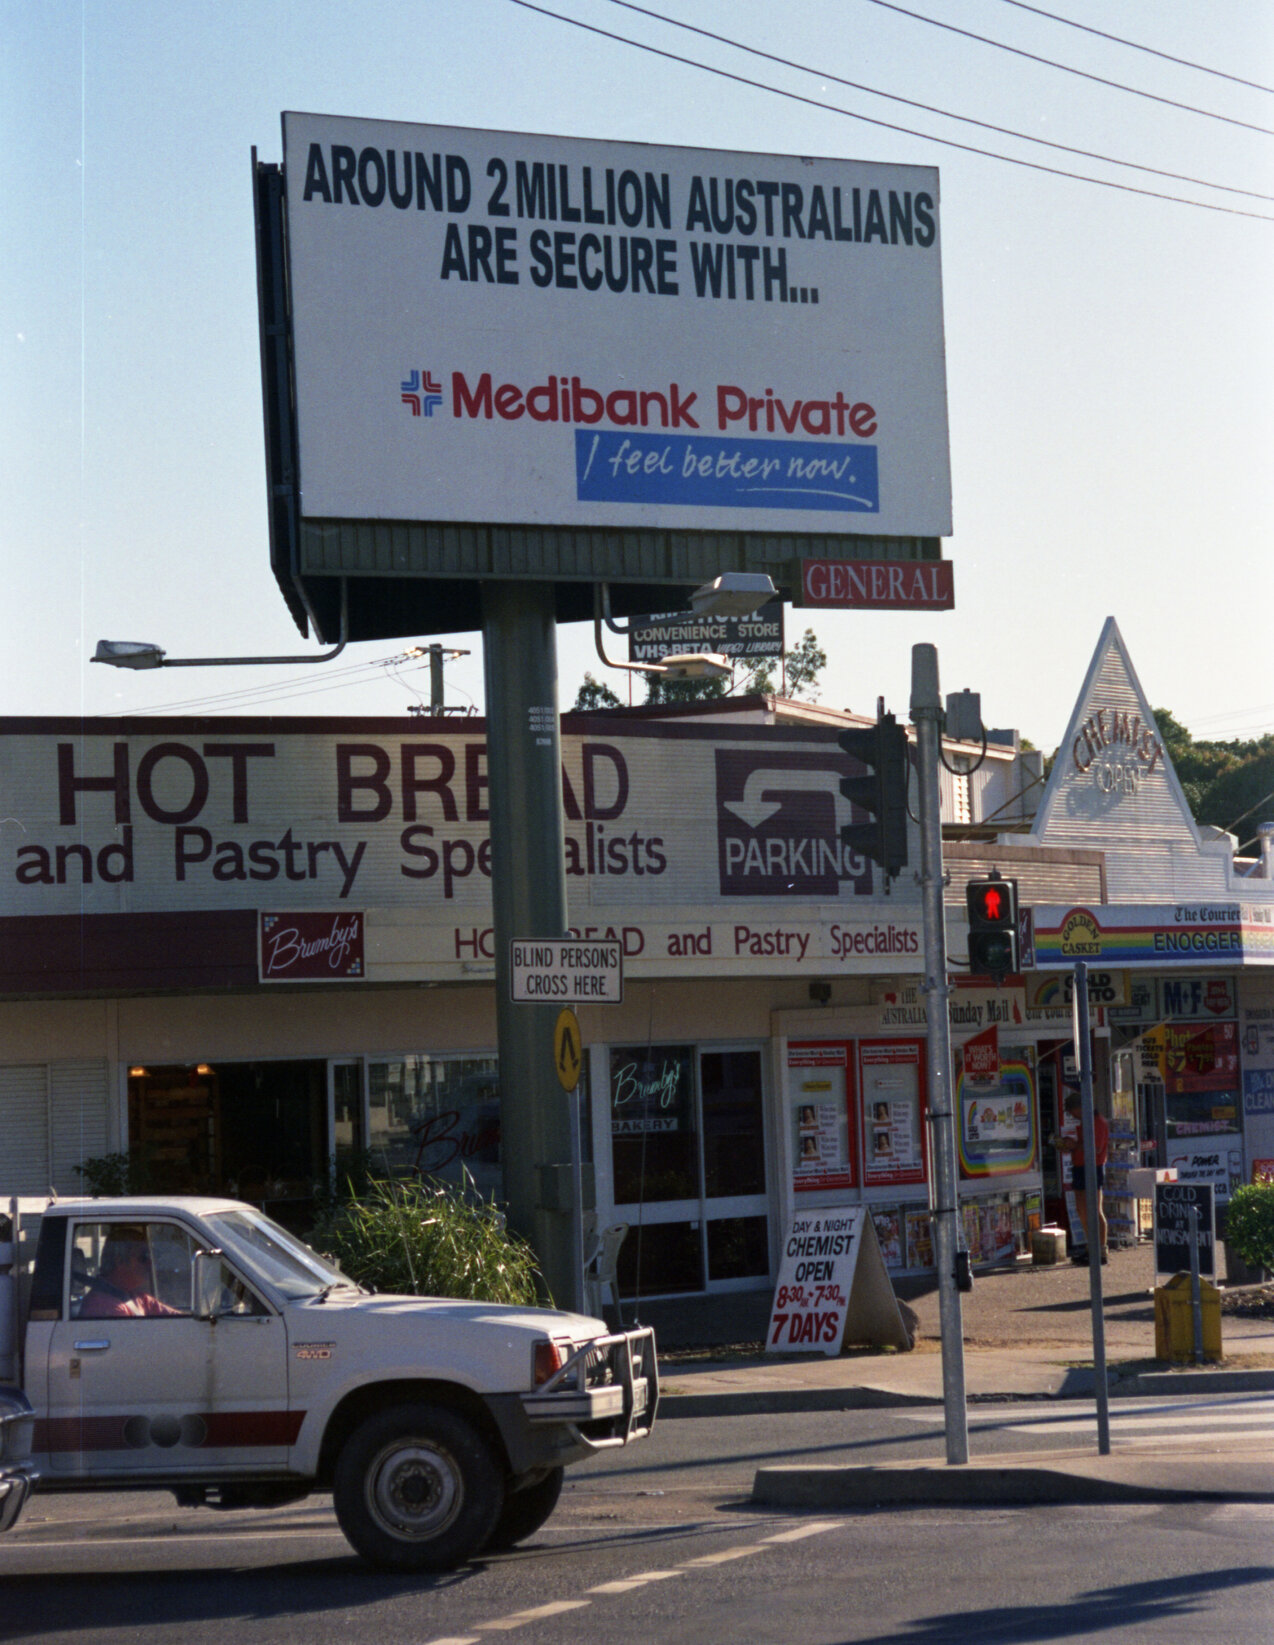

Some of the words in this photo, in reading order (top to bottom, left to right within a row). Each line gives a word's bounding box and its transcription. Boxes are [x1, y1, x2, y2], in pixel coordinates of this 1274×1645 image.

[302, 142, 471, 214] AROUND
[486, 157, 510, 216] 2
[516, 161, 672, 230] MILLION
[685, 175, 936, 248] AUSTRALIANS
[440, 222, 519, 285] ARE
[530, 229, 679, 296] SECURE
[690, 242, 820, 304] WITH...
[452, 371, 700, 429] Medibank
[717, 384, 878, 438] Private
[607, 440, 674, 482] feel
[681, 442, 782, 482] better
[785, 453, 859, 484] now.
[805, 563, 949, 602] GENERAL
[634, 624, 727, 642] CONVENIENCE
[738, 623, 780, 637] STORE
[746, 641, 782, 653] LIBRARY
[1073, 708, 1163, 774] CHEMIST
[57, 742, 275, 826] HOT
[336, 742, 629, 824] BRED
[15, 825, 134, 885] and
[174, 827, 367, 899] Pastry
[400, 823, 667, 899] Spealists
[725, 837, 866, 878] PARKING
[1174, 906, 1197, 922] The
[1063, 915, 1099, 941] GOLDEN
[267, 915, 358, 975] Brumby's
[668, 927, 713, 956] and
[734, 927, 810, 962] Pastry
[830, 925, 920, 960] Specialists
[1062, 941, 1101, 955] CASKET
[514, 948, 554, 968] BLIND
[560, 948, 618, 969] PERSONS
[527, 975, 568, 995] CROSS
[574, 976, 607, 996] HERE
[1064, 973, 1112, 989] GLD
[1063, 987, 1117, 1004] LTTO
[881, 1006, 928, 1025] AUSTRALIA
[986, 1000, 1009, 1022] Mail
[614, 1060, 680, 1109] Brumby's
[611, 1119, 675, 1133] BAKERY
[1176, 1120, 1230, 1136] CHEMIST
[1163, 1186, 1197, 1201] COLD
[792, 1221, 813, 1233] DAY
[814, 1221, 821, 1232] &
[824, 1219, 855, 1232] NIGHT
[786, 1235, 855, 1257] CHEMIST
[795, 1261, 834, 1282] OPEN
[771, 1313, 789, 1344] 7
[787, 1312, 839, 1343] DAYS
